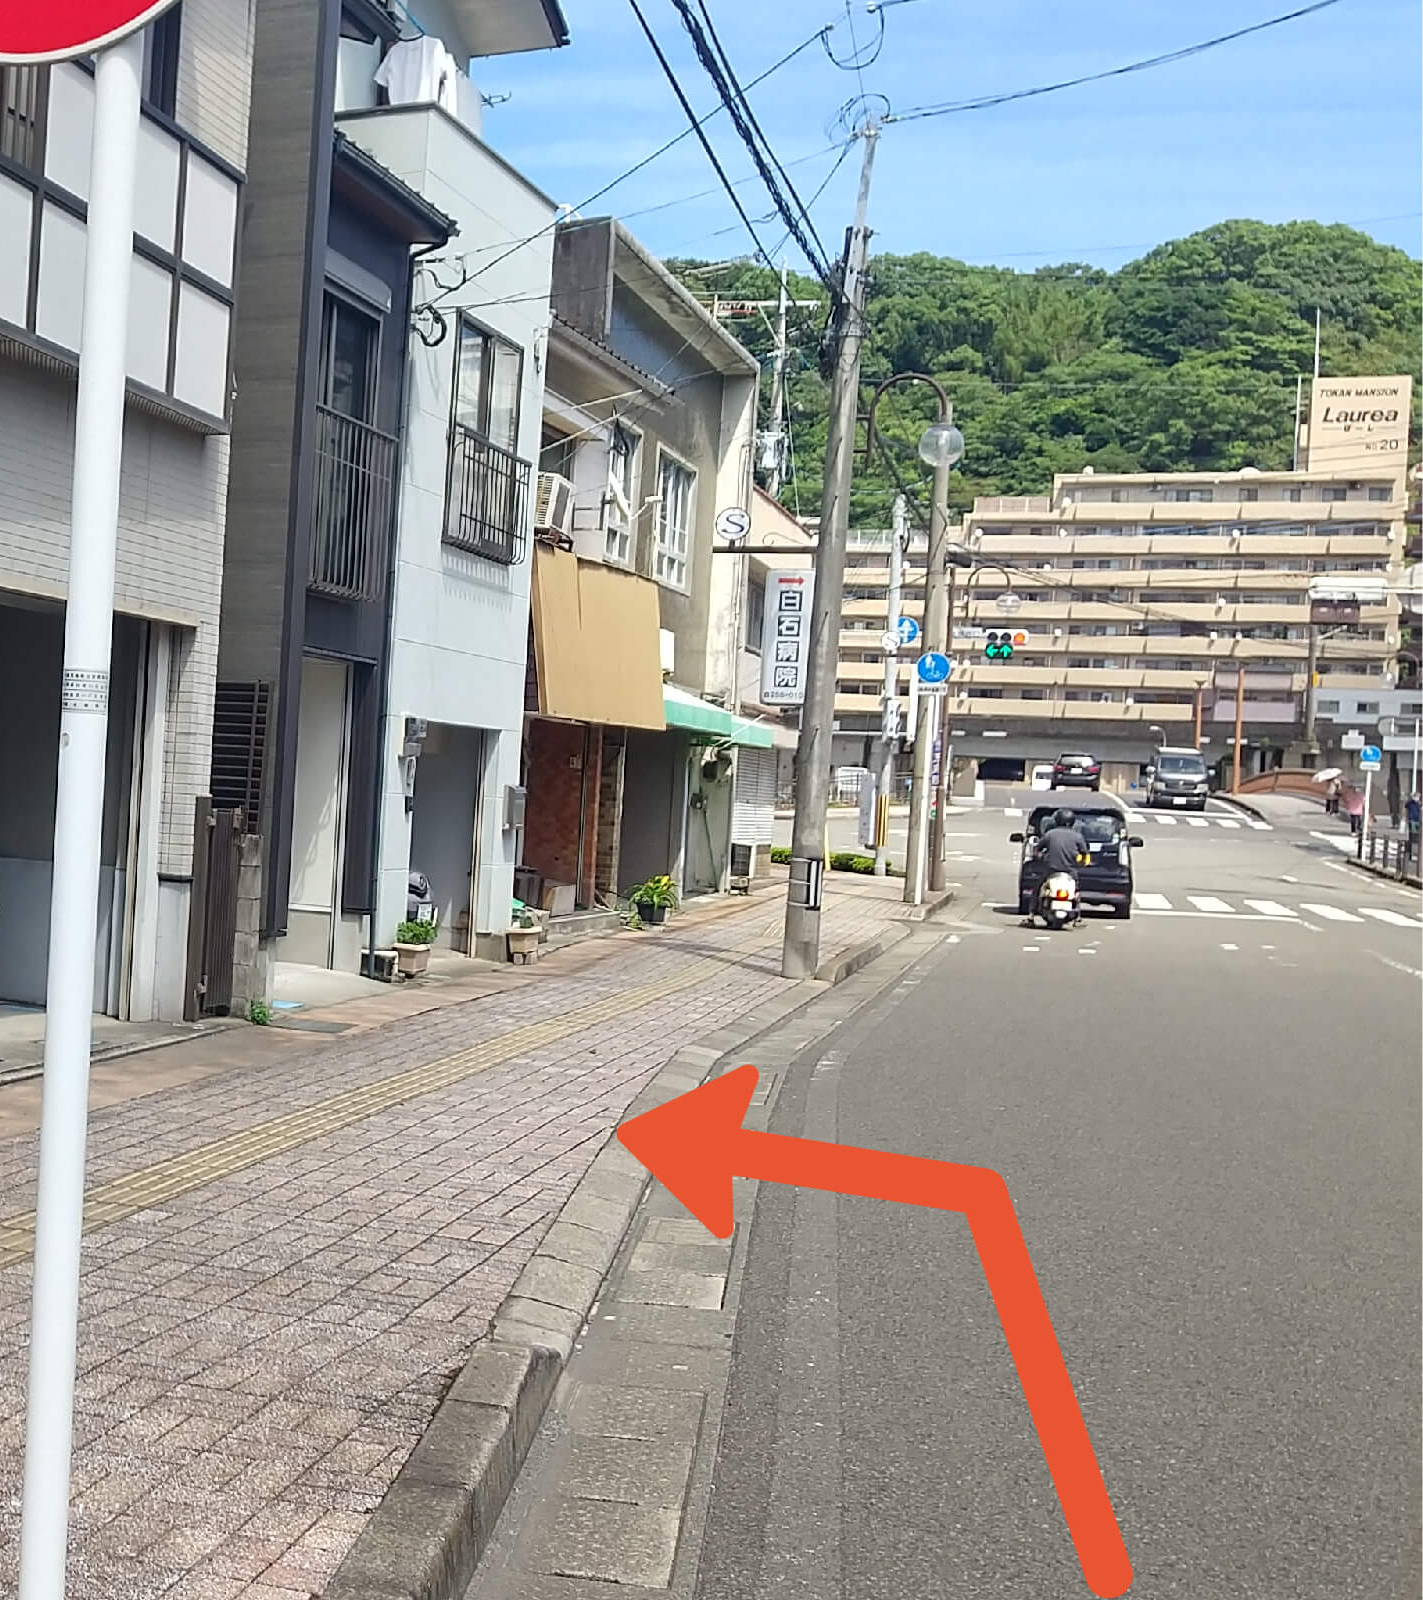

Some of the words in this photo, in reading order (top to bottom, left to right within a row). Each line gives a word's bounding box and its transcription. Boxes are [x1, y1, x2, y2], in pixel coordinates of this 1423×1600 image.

[1321, 389, 1352, 398] TOKAN
[1355, 387, 1399, 397] MANSION
[1322, 406, 1399, 423] Laurea
[1380, 439, 1399, 450] 20
[721, 513, 745, 534] S
[773, 589, 803, 688] 白石病院
